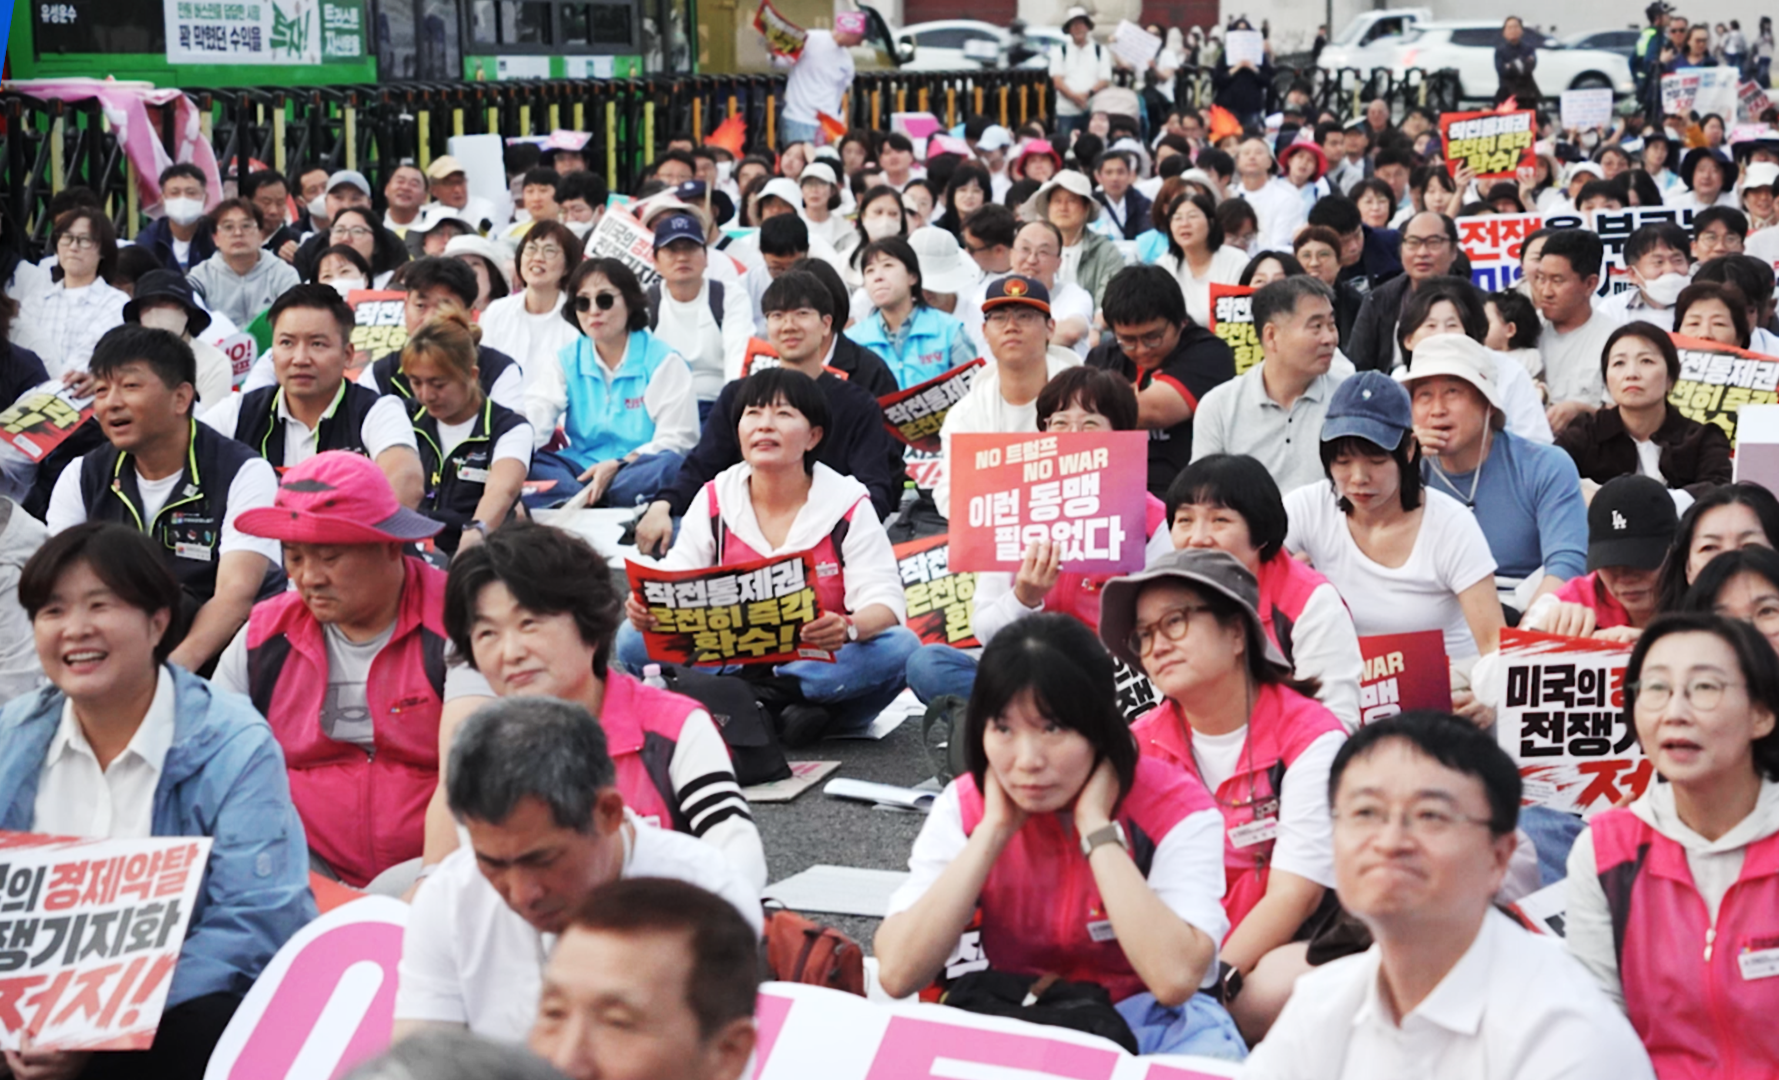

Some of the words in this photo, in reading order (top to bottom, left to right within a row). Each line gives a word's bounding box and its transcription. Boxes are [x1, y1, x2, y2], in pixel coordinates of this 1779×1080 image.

[194, 25, 227, 51] 막혔던
[230, 25, 262, 52] 수익을
[1449, 112, 1530, 140] 작전통제권
[225, 339, 252, 362] O!
[898, 409, 947, 441] 온전
[975, 448, 1001, 470] NO
[1005, 436, 1058, 465] 트럼프
[1023, 459, 1053, 483] NO
[1059, 447, 1109, 476] WAR
[968, 488, 1020, 528] 이런
[1028, 472, 1101, 522] 동맹
[994, 514, 1127, 563] 필요없다
[1612, 510, 1627, 530] LA
[643, 556, 806, 609] 작전통제권
[748, 586, 815, 627] 즉각
[693, 624, 796, 662] 환수!
[1506, 664, 1606, 708] 미국의
[43, 842, 199, 912] 경제약탈
